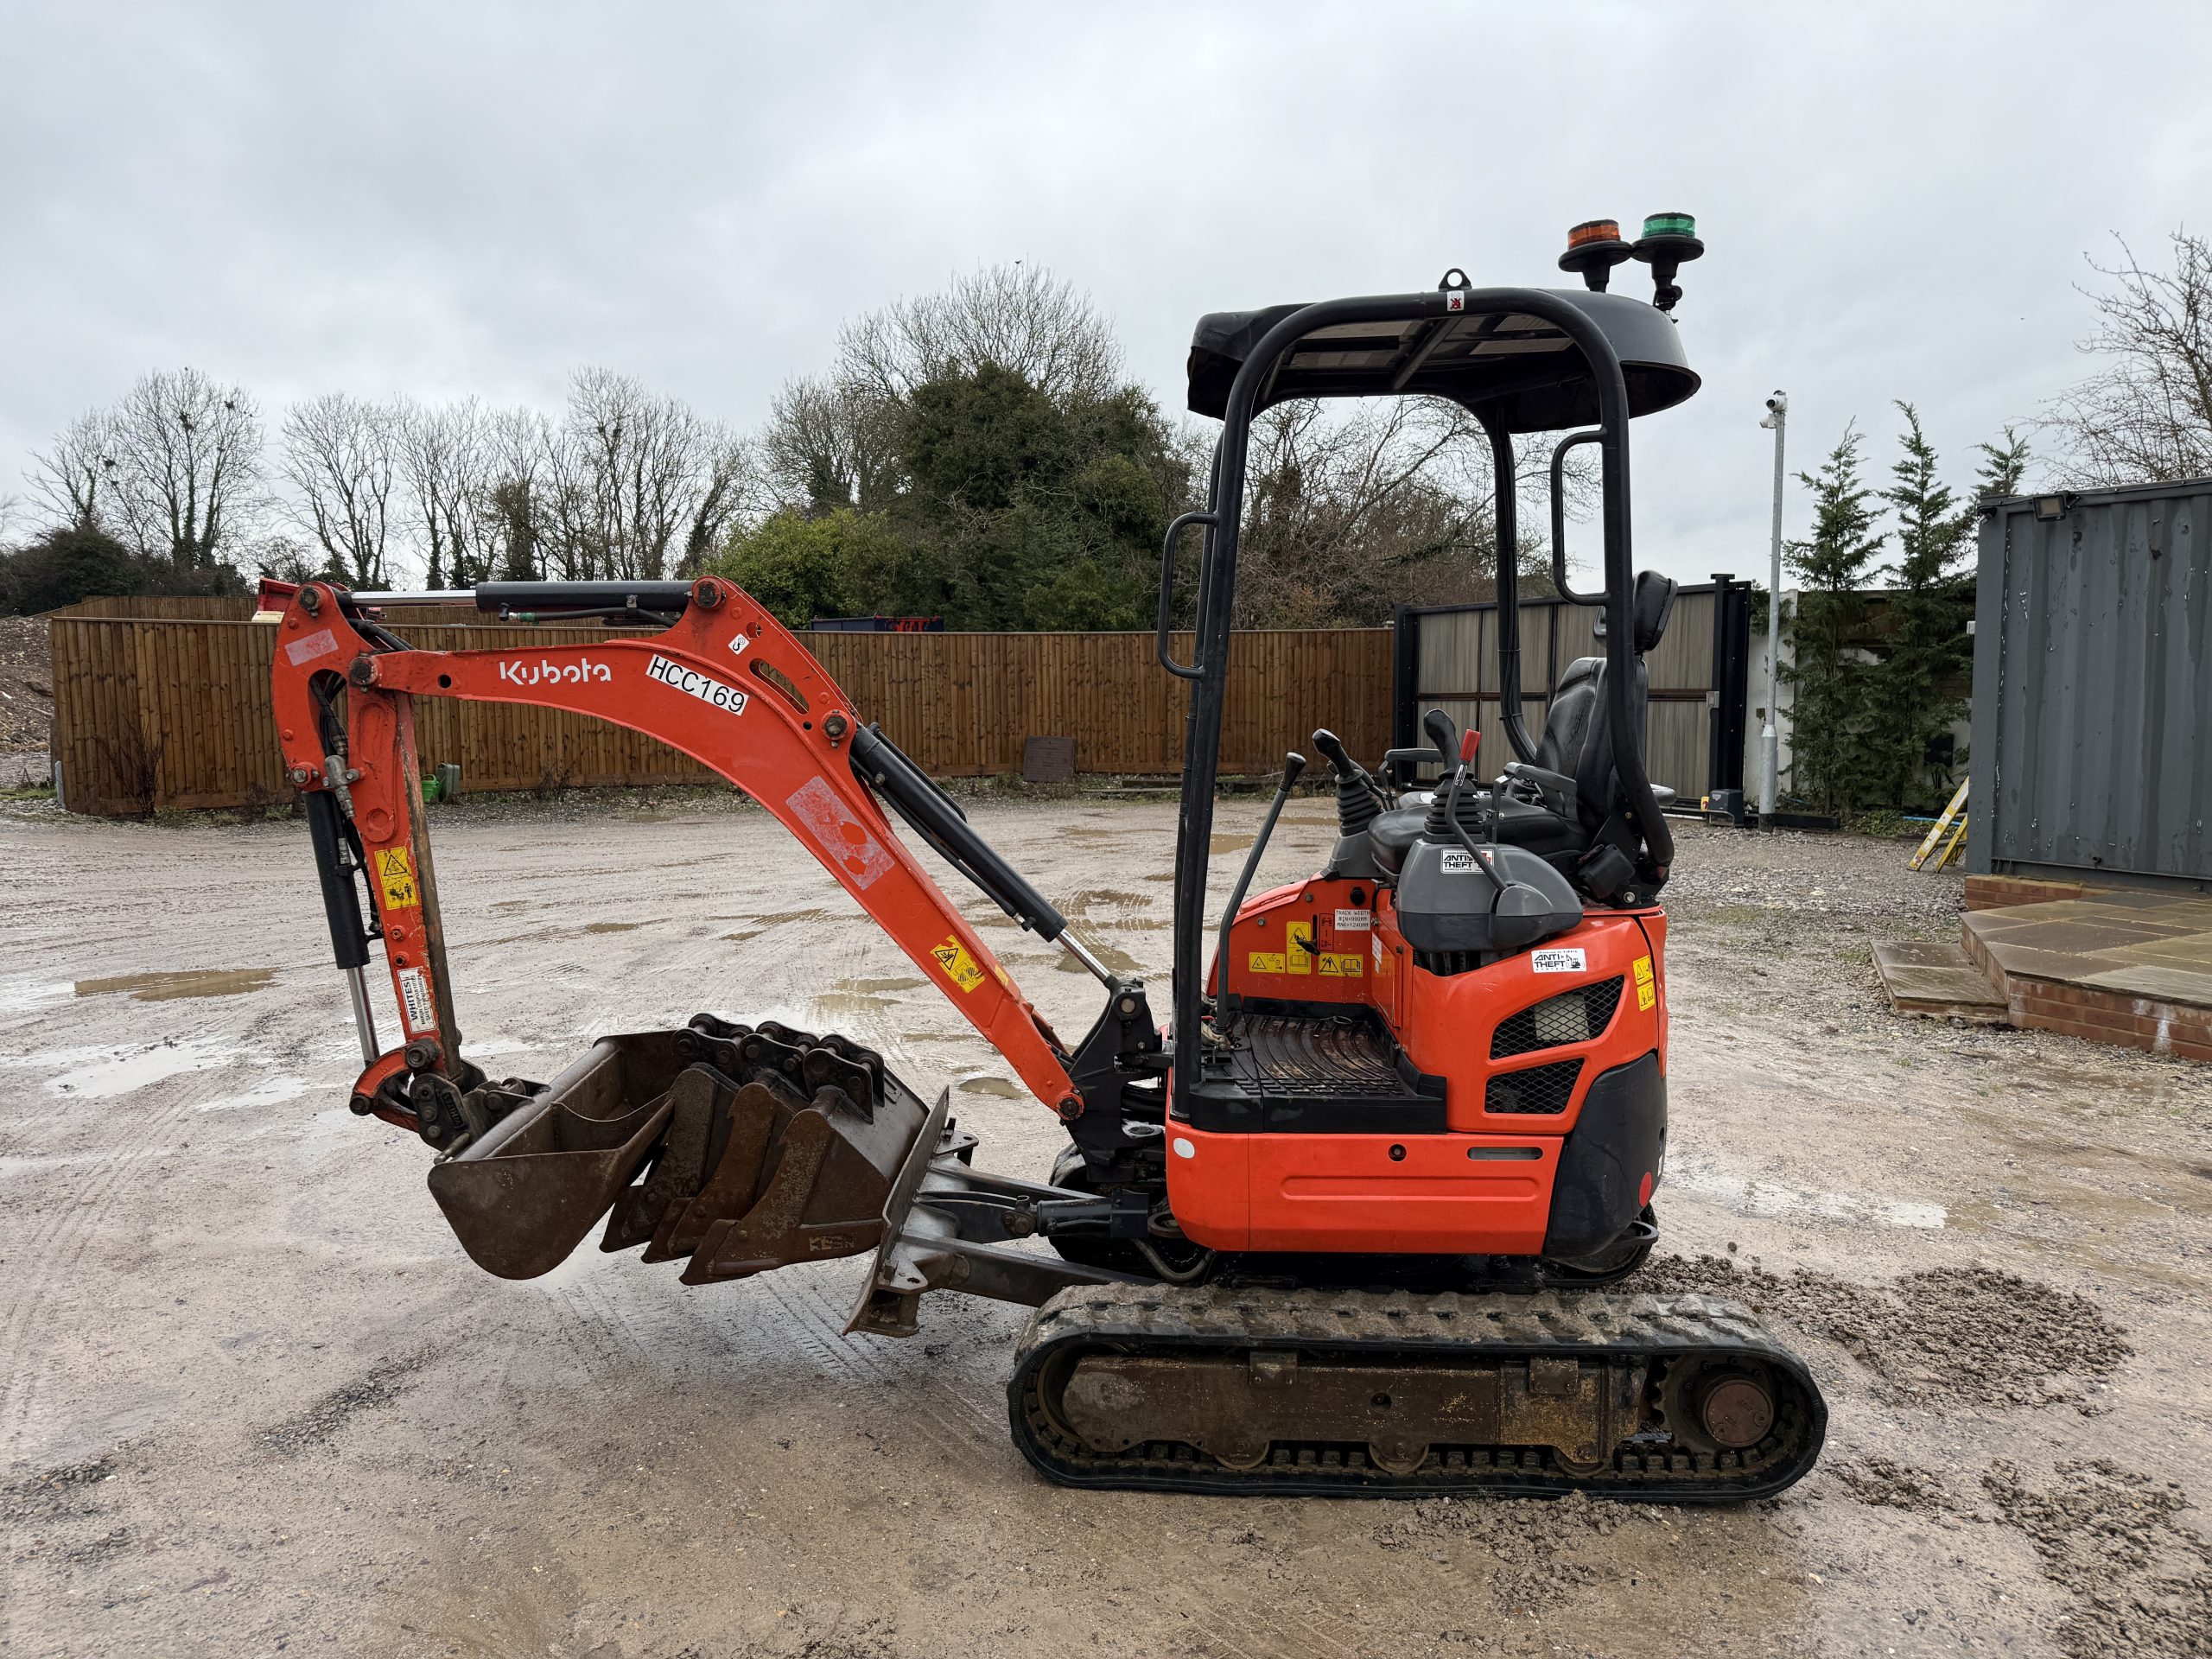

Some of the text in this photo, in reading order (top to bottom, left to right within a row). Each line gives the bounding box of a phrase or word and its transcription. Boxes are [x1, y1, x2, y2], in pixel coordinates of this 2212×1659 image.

[499, 658, 612, 685] Kubota
[649, 656, 745, 713] HCC169
[403, 981, 418, 1021] WHITES
